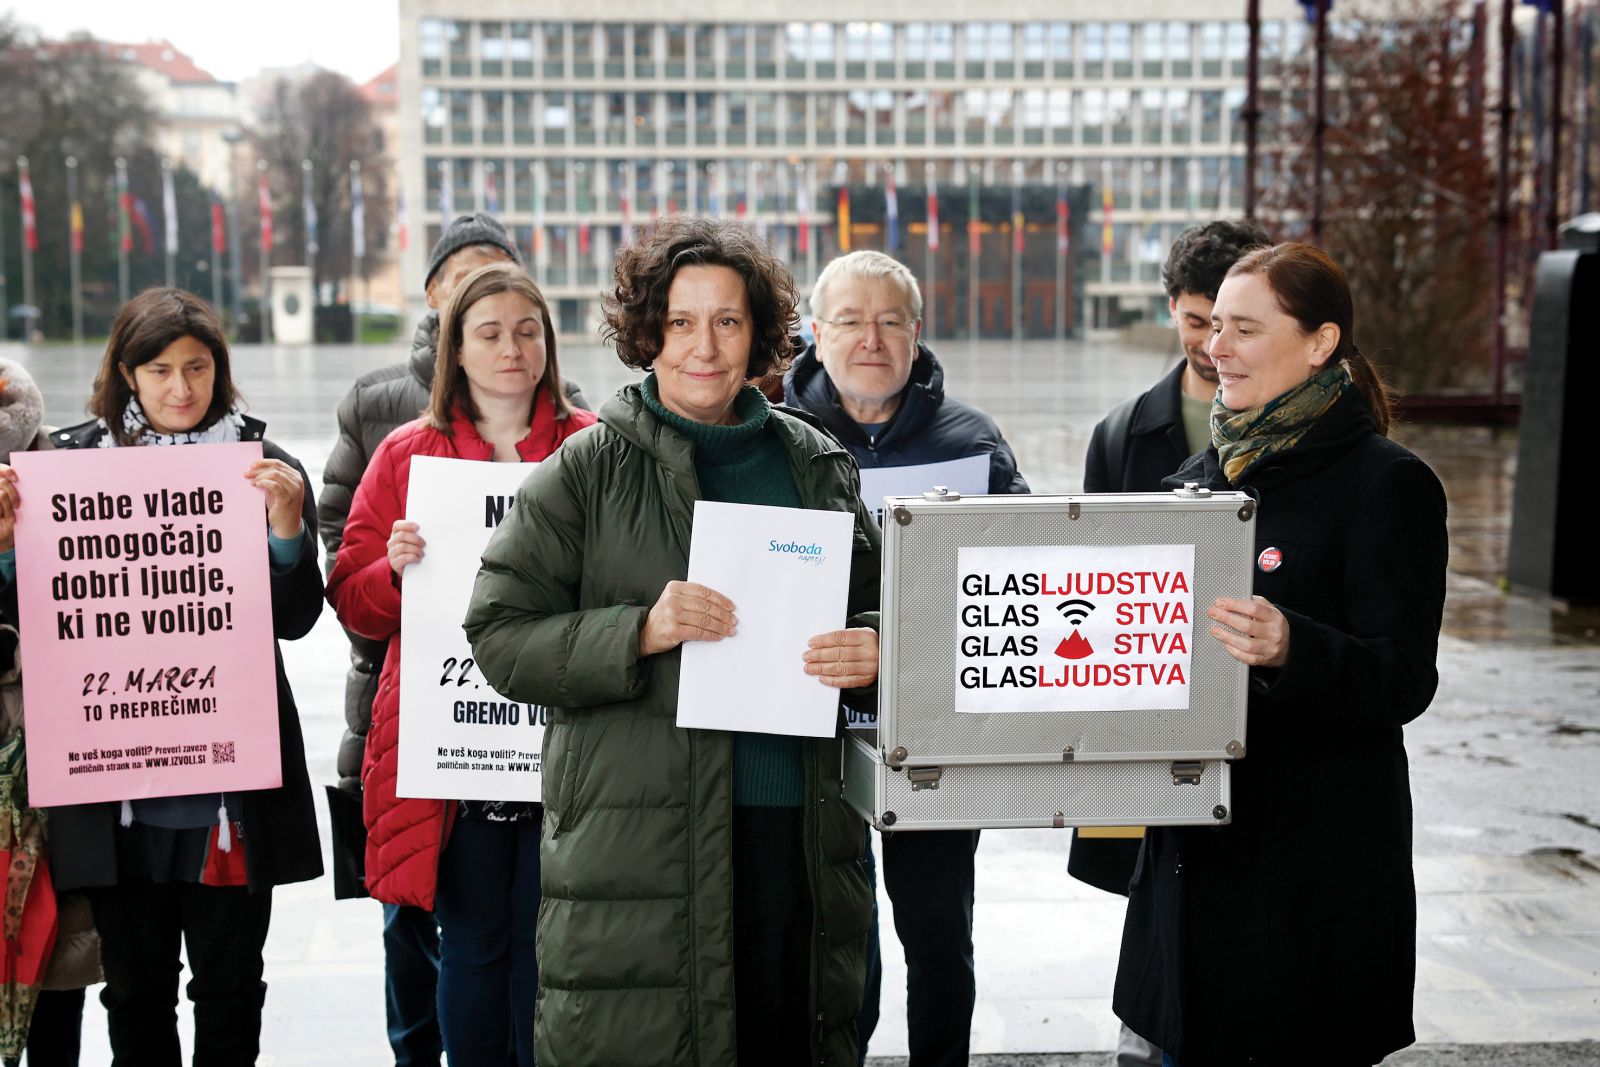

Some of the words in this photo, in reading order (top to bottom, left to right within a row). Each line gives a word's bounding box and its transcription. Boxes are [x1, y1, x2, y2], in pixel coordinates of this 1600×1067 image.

[51, 492, 133, 522] Slabe
[143, 487, 224, 517] vlade
[58, 523, 223, 562] omogočajo
[768, 540, 822, 555] Svoboda
[52, 566, 129, 601] dobri
[140, 562, 234, 600] ljudje,
[57, 608, 84, 640] ki
[95, 611, 131, 638] ne
[141, 601, 233, 636] volijo!
[961, 604, 1040, 628] GLAS
[1115, 601, 1189, 626] STVA
[960, 635, 1039, 658] GLAS
[1113, 632, 1188, 655] STVA
[82, 672, 116, 697] 22.
[124, 665, 216, 694] MARCA
[440, 657, 479, 689] 22.
[84, 705, 102, 722] TO
[110, 695, 217, 720] PREPREČIMO!
[453, 700, 520, 726] GREMO
[68, 751, 80, 761] Ne
[82, 748, 98, 760] veš
[100, 750, 123, 760] koga
[125, 745, 153, 757] voliti?
[154, 745, 181, 755] Preveri
[183, 743, 207, 754] zaveze
[69, 761, 104, 775] političnih
[106, 761, 130, 772] strank
[132, 761, 144, 769] na:
[145, 754, 206, 768] WWW.IZVOLI.SI
[437, 747, 448, 757] Ne
[450, 746, 465, 757] veš
[467, 748, 488, 759] koga
[490, 749, 516, 760] voliti?
[436, 760, 470, 770] političnih
[471, 762, 494, 771] strank
[508, 762, 541, 772] WWW.IZ
